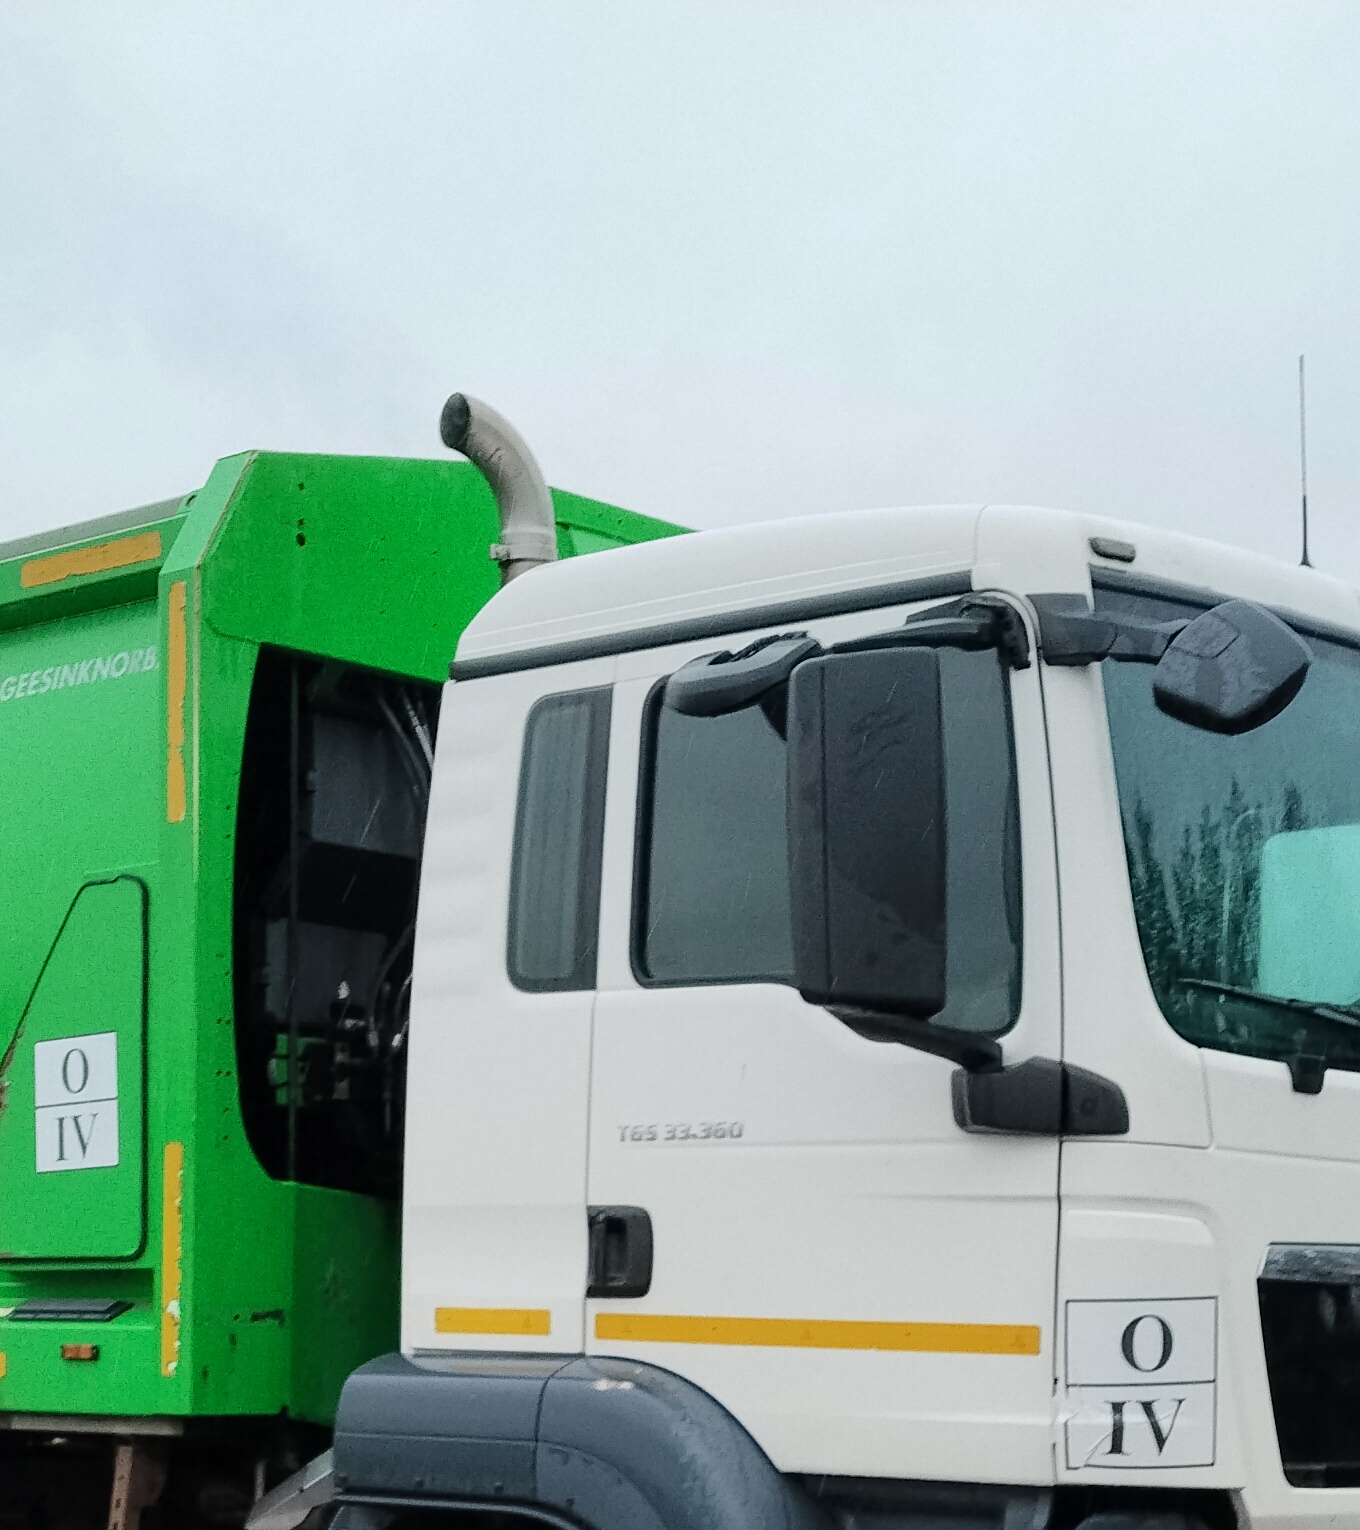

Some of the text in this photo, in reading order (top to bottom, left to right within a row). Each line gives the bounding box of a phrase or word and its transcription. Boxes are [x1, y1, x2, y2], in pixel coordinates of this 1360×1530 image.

[55, 1112, 99, 1163] IV
[664, 1121, 745, 1142] 33.360
[1101, 1397, 1189, 1457] IV
